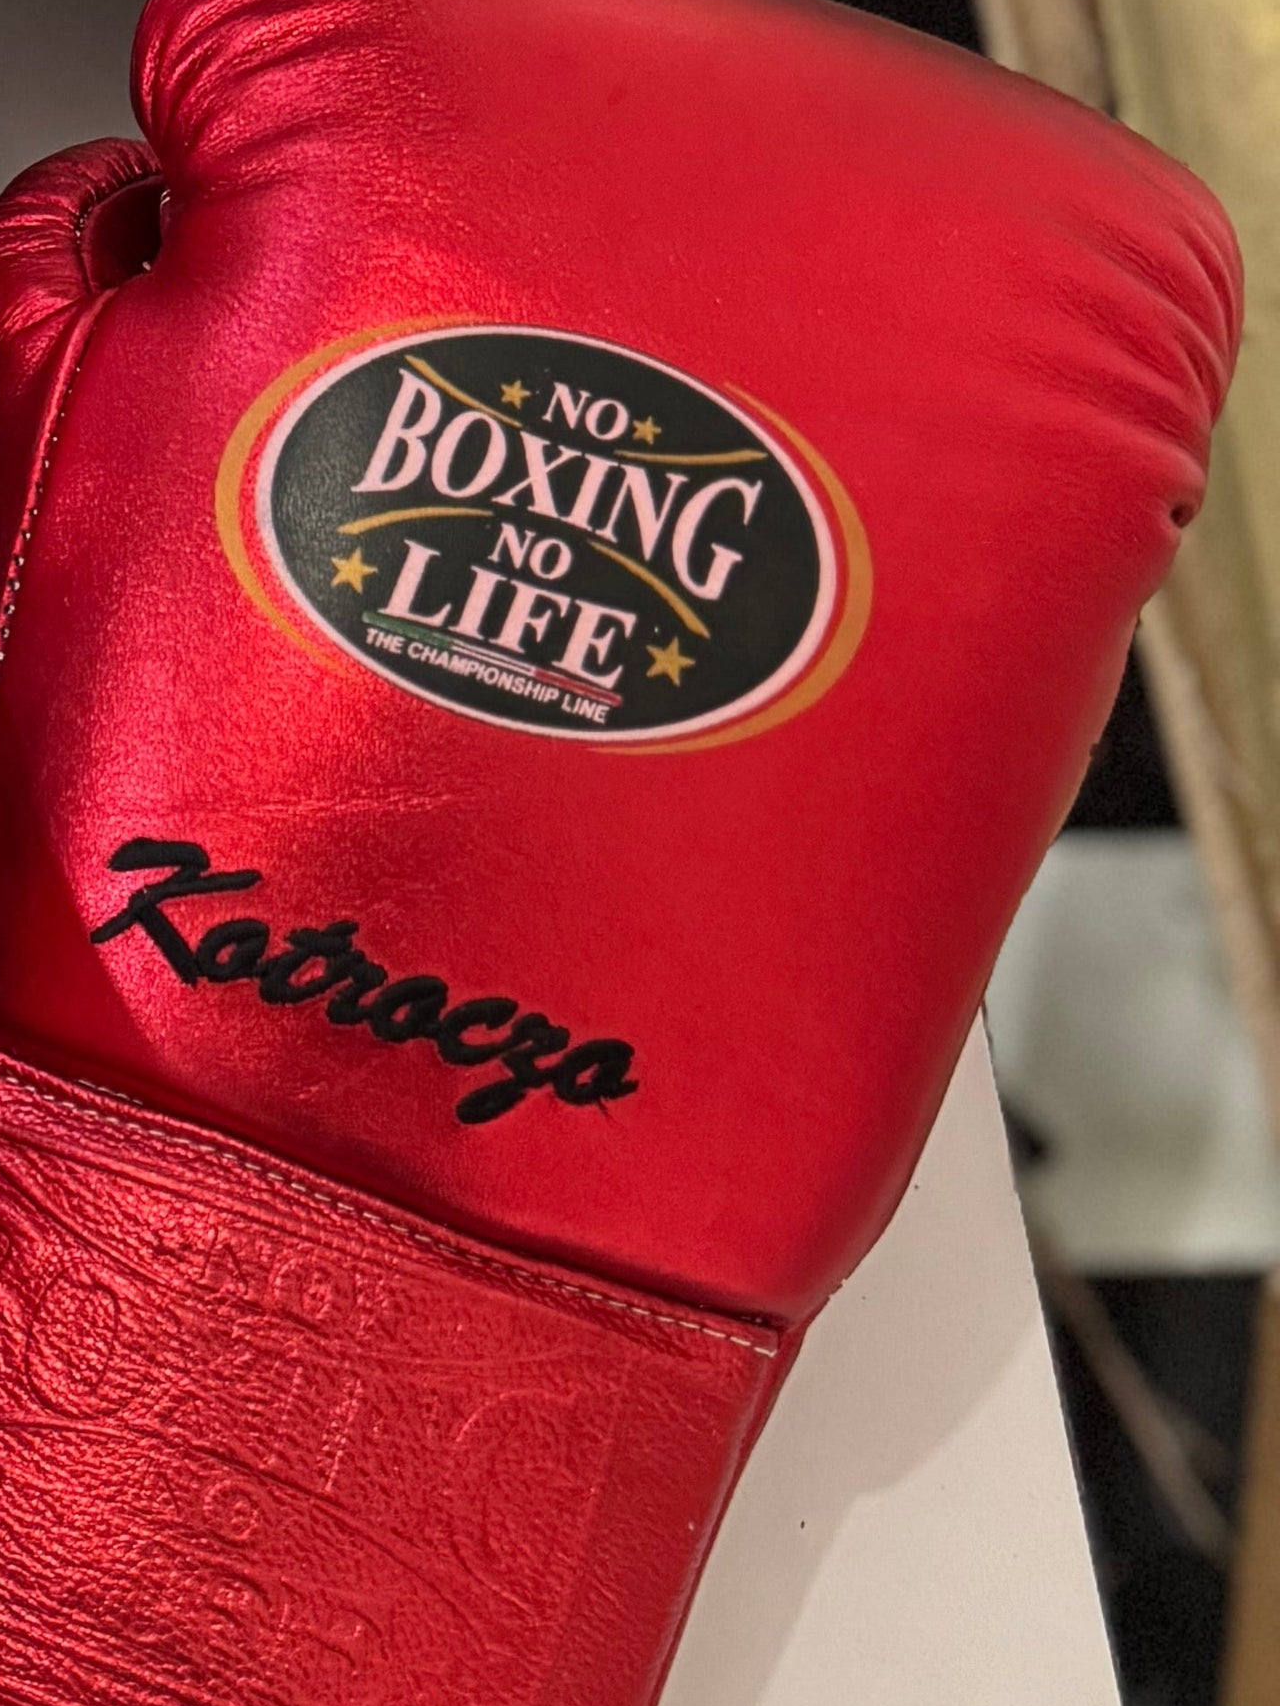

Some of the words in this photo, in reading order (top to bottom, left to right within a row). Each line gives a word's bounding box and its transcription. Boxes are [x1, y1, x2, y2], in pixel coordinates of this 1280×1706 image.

[541, 381, 630, 441] NO
[351, 369, 763, 603] BOXING
[491, 522, 574, 582] NO
[375, 539, 637, 689] LIFE
[365, 627, 406, 655] THE
[406, 638, 560, 704] CHAMPIONSHIP
[560, 693, 610, 725] LINE
